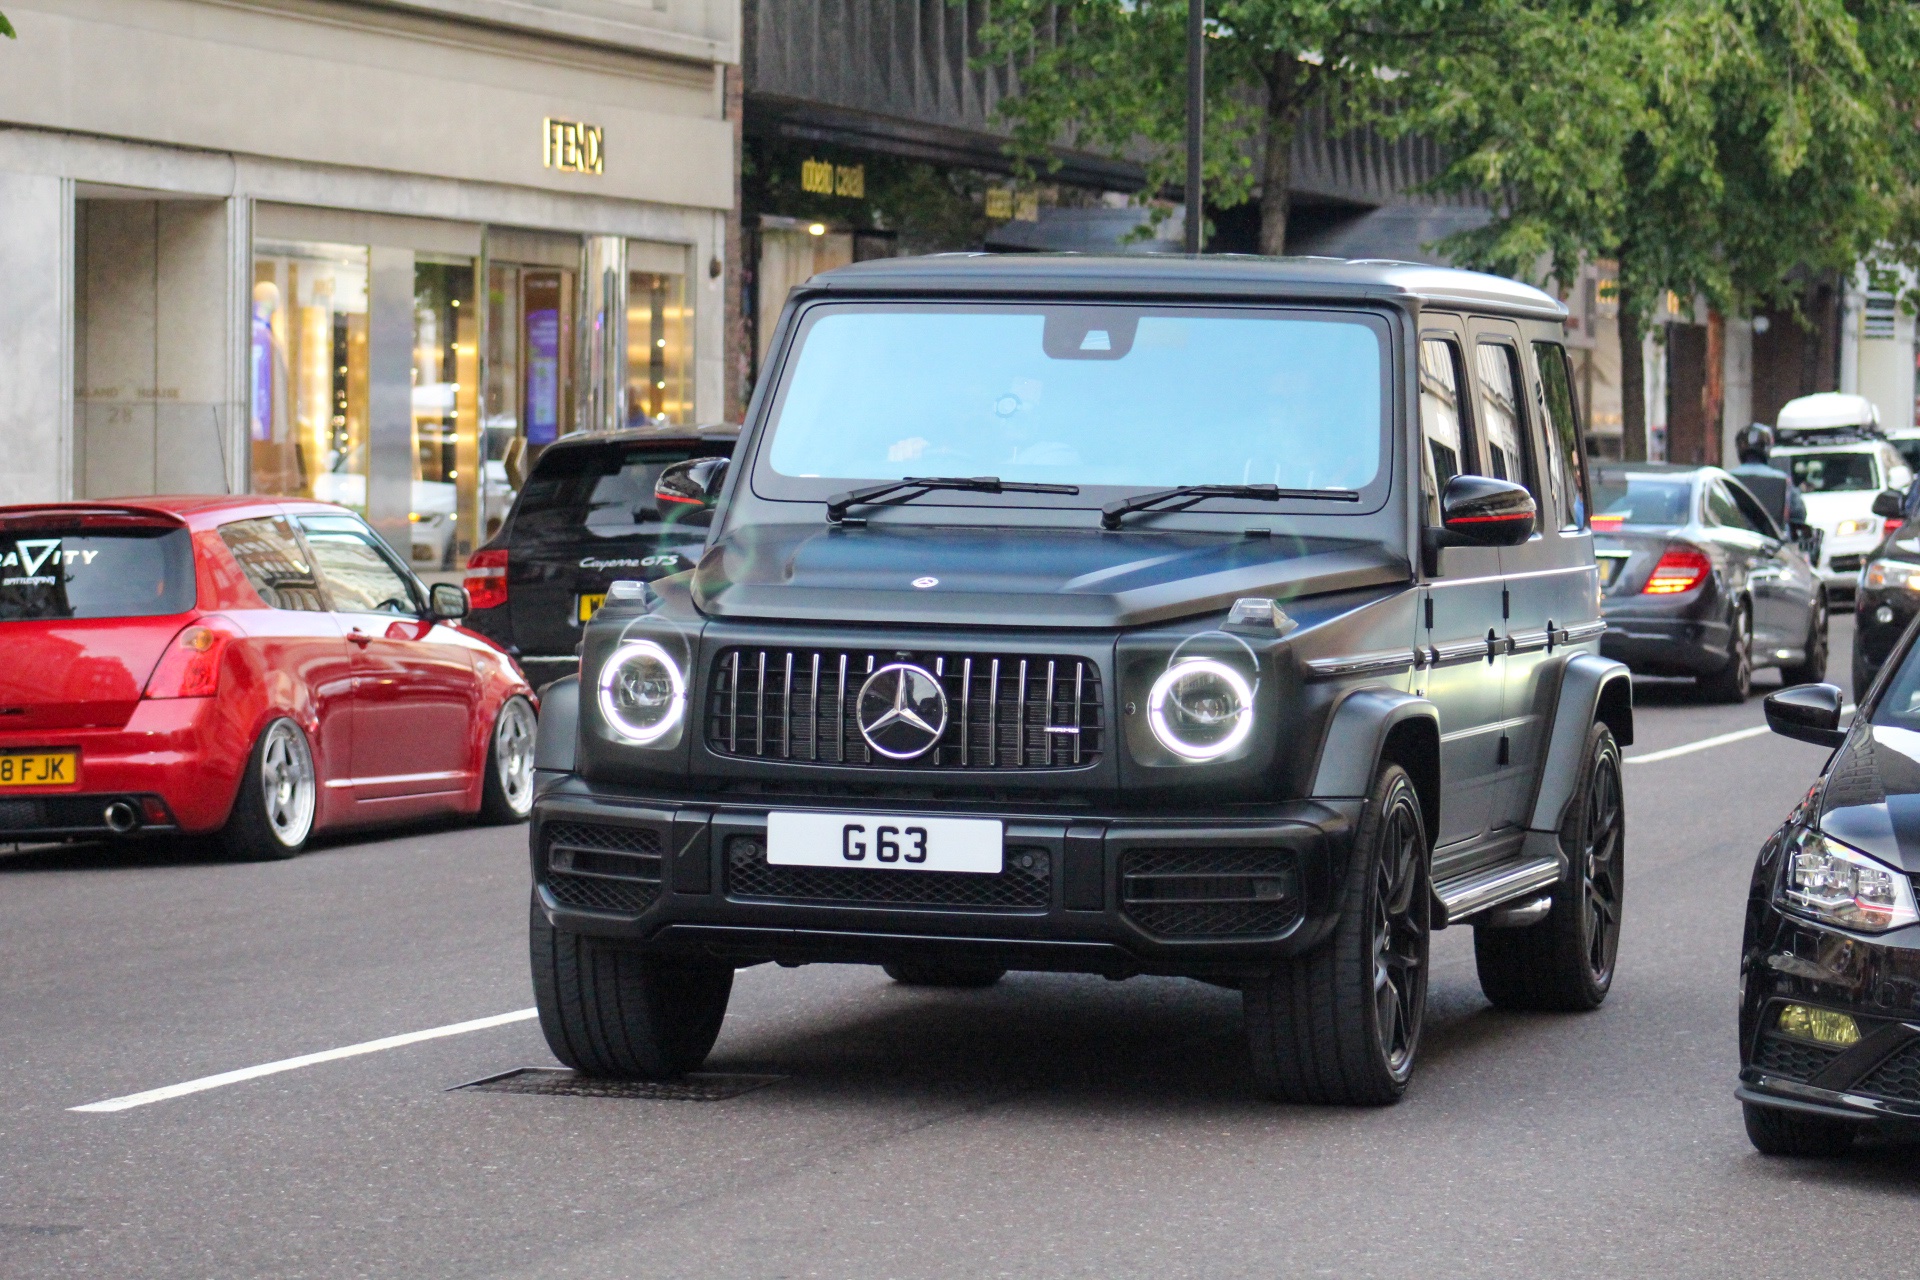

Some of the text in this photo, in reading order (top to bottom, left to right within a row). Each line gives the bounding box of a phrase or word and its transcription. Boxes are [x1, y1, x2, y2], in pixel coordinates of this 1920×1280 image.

[580, 555, 679, 572] Cayenne GTS
[21, 757, 65, 781] FJK
